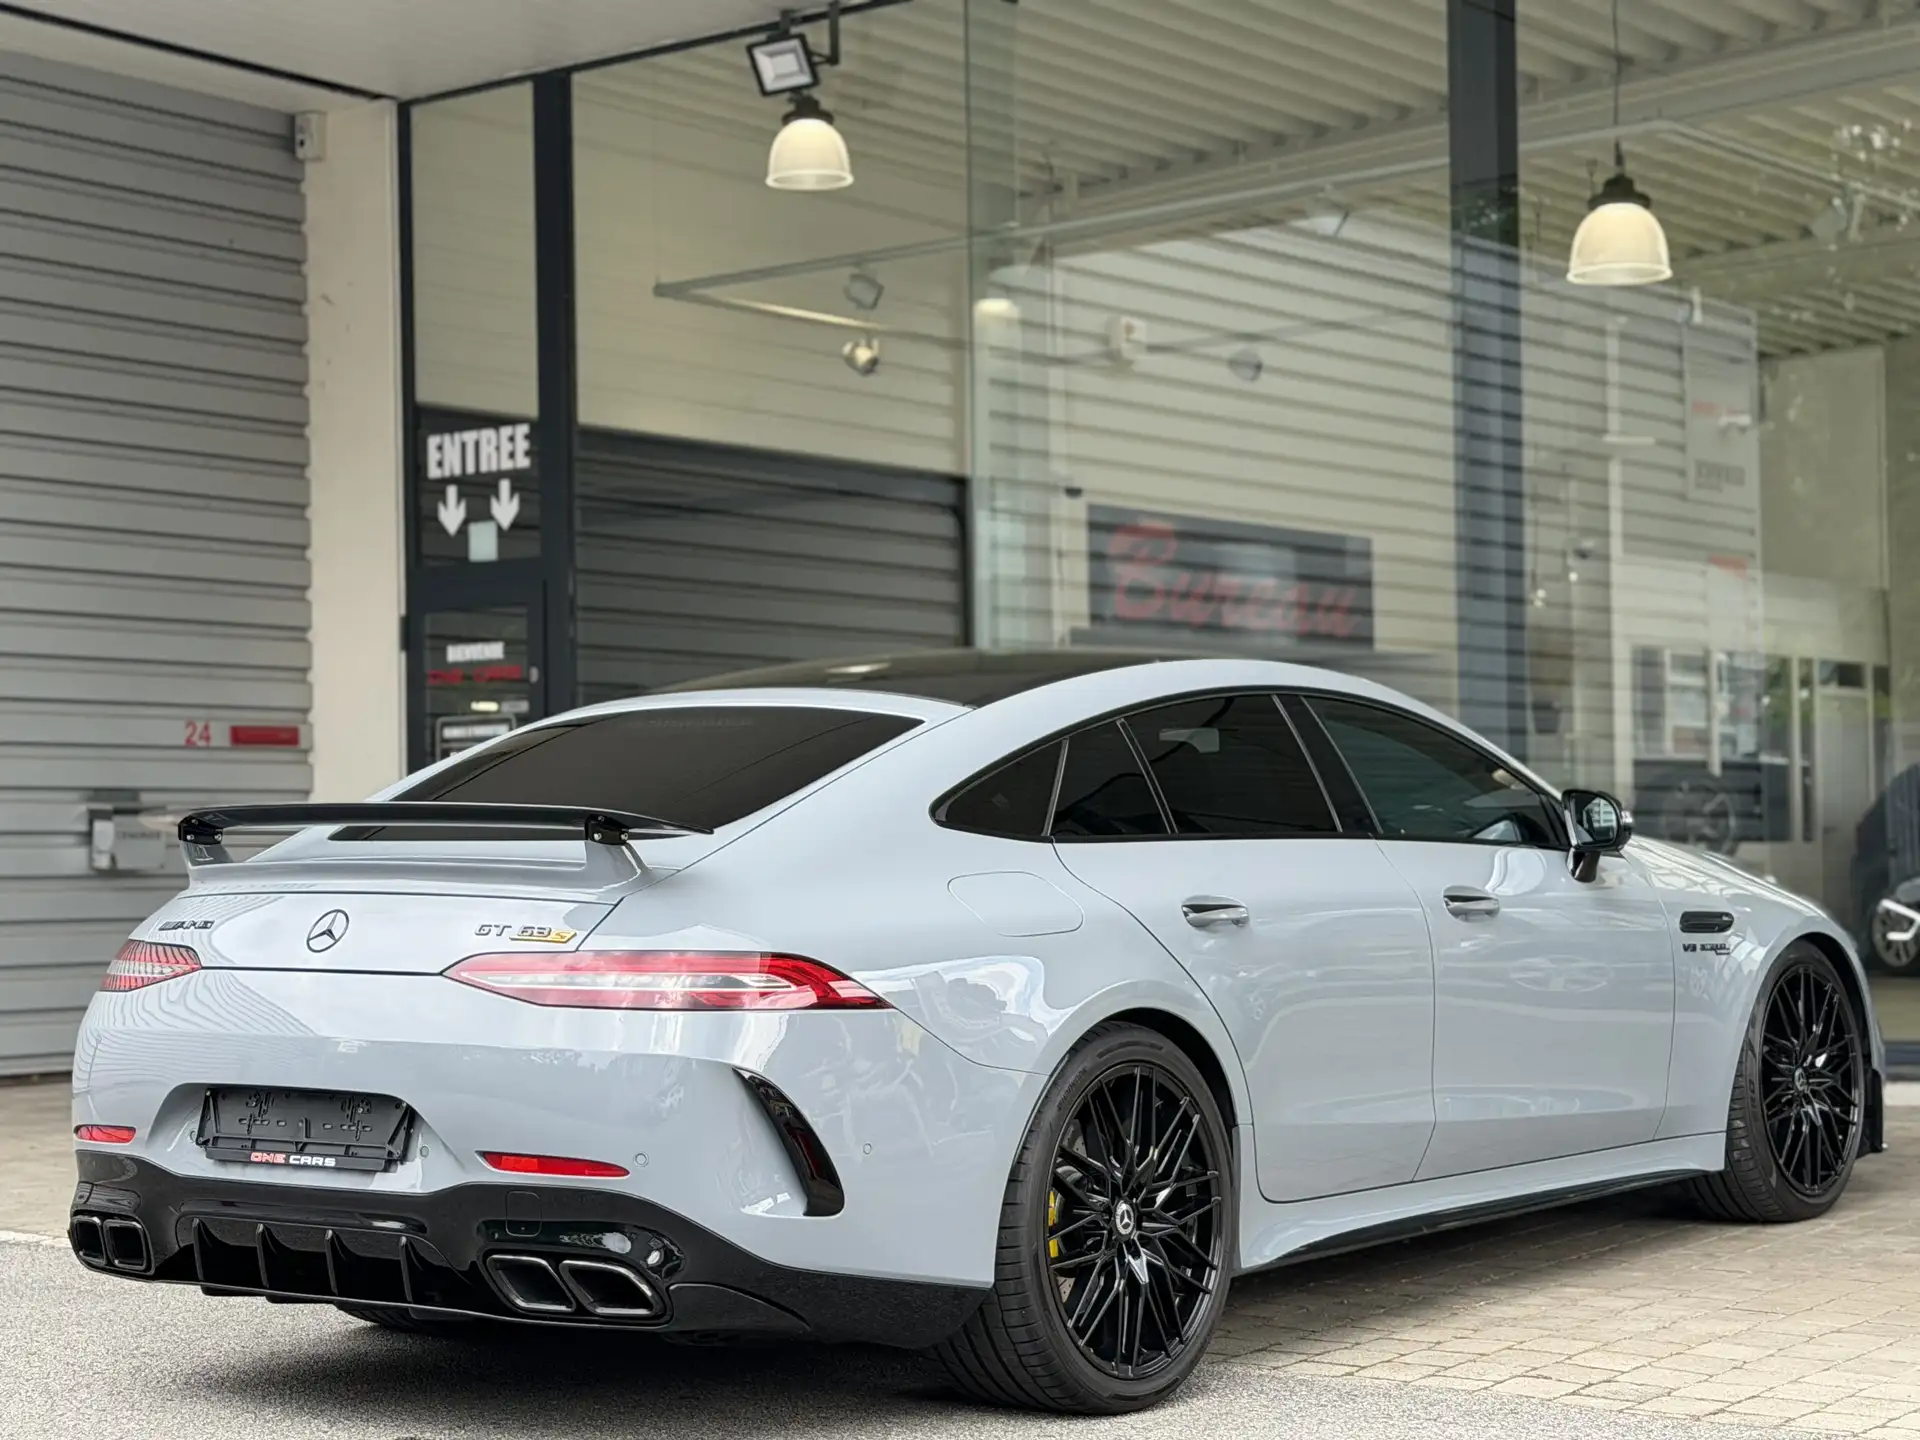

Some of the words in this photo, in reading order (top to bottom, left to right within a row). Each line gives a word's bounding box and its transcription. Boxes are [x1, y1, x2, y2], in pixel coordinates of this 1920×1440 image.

[427, 423, 531, 480] ENTREE
[184, 719, 211, 747] 24
[475, 924, 512, 937] GT
[250, 1152, 286, 1164] ONE
[289, 1155, 336, 1167] CARS
